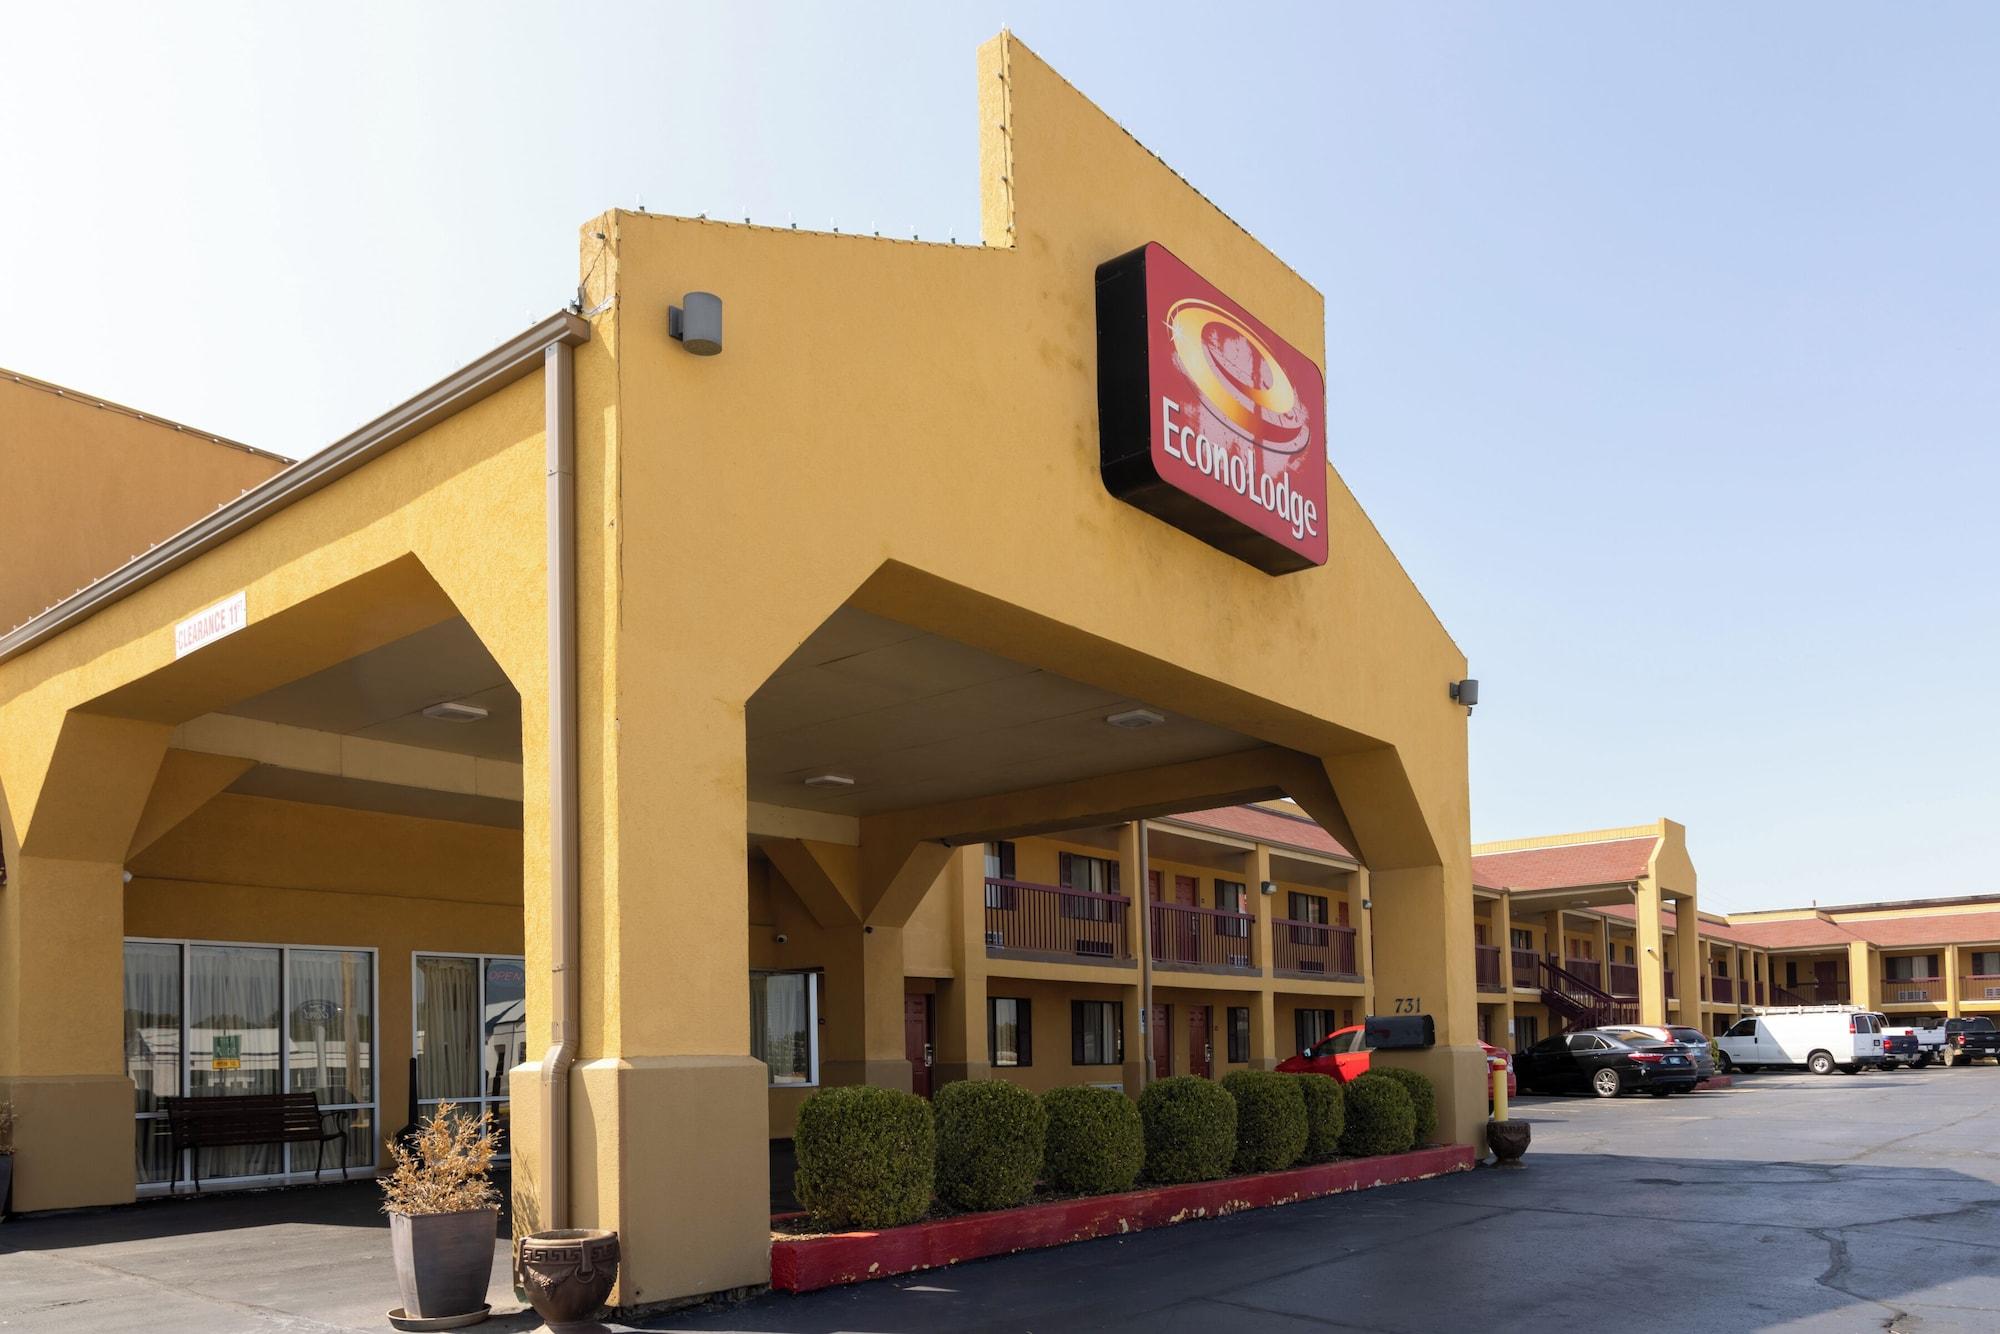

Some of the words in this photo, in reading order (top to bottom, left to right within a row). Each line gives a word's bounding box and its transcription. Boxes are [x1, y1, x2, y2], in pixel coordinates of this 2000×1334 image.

[178, 608, 226, 650] CLEARANCE
[489, 970, 521, 983] OPEN
[1395, 997, 1421, 1014] 731
